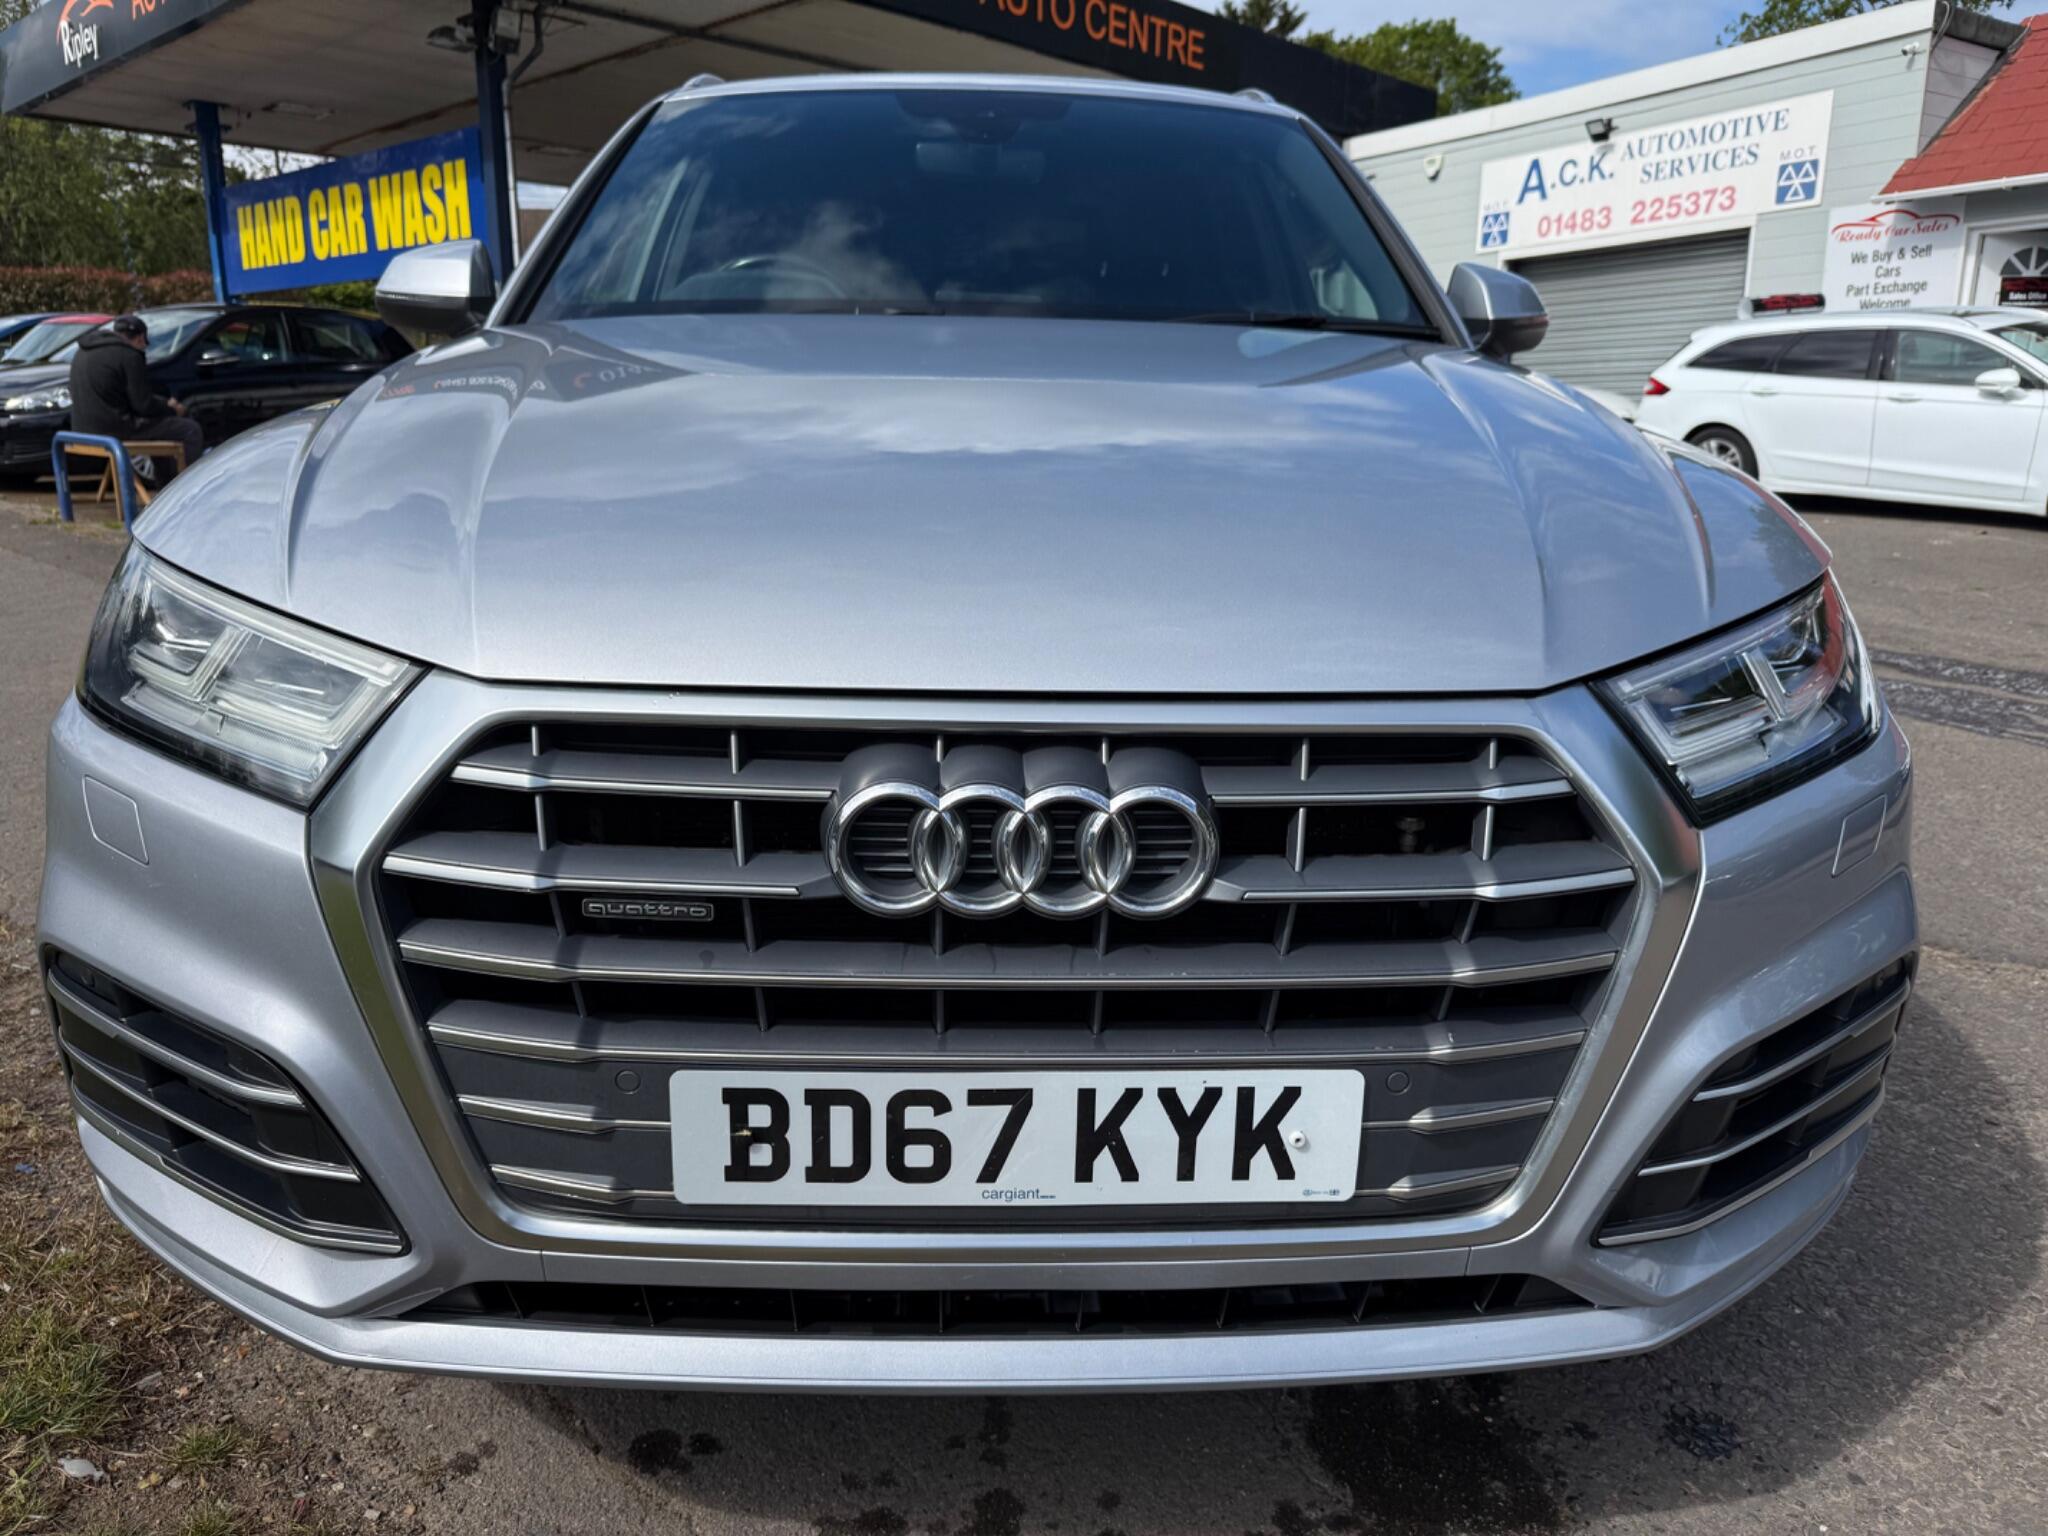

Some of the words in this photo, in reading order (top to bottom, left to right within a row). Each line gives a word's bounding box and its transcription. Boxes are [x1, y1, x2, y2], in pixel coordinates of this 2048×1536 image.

[60, 20, 99, 68] Ripley
[996, 0, 1076, 31] TO
[1084, 0, 1205, 70] CENTRE
[1516, 150, 1615, 205] A.C.K.
[1620, 108, 1790, 163] AUTOMOTIVE
[1639, 143, 1760, 185] SERVICES
[237, 196, 306, 270] HAND
[308, 182, 368, 261] CAR
[368, 158, 472, 251] WASH
[1537, 206, 1612, 238] 01483
[1630, 185, 1737, 226] 225373
[1838, 227, 1882, 242] Ready
[1884, 225, 1910, 237] Car
[1912, 220, 1950, 234] Sales
[1851, 252, 1868, 264] We
[1872, 250, 1893, 264] Buy
[1897, 248, 1905, 260] &
[1911, 245, 1933, 259] Sell
[1875, 266, 1902, 278] Cars
[1846, 284, 1869, 297] Part
[1873, 280, 1928, 295] Exchange
[1859, 298, 1911, 310] Welcome
[588, 903, 707, 917] quattro
[722, 1088, 1034, 1184] BD67
[1074, 1086, 1303, 1182] KYK
